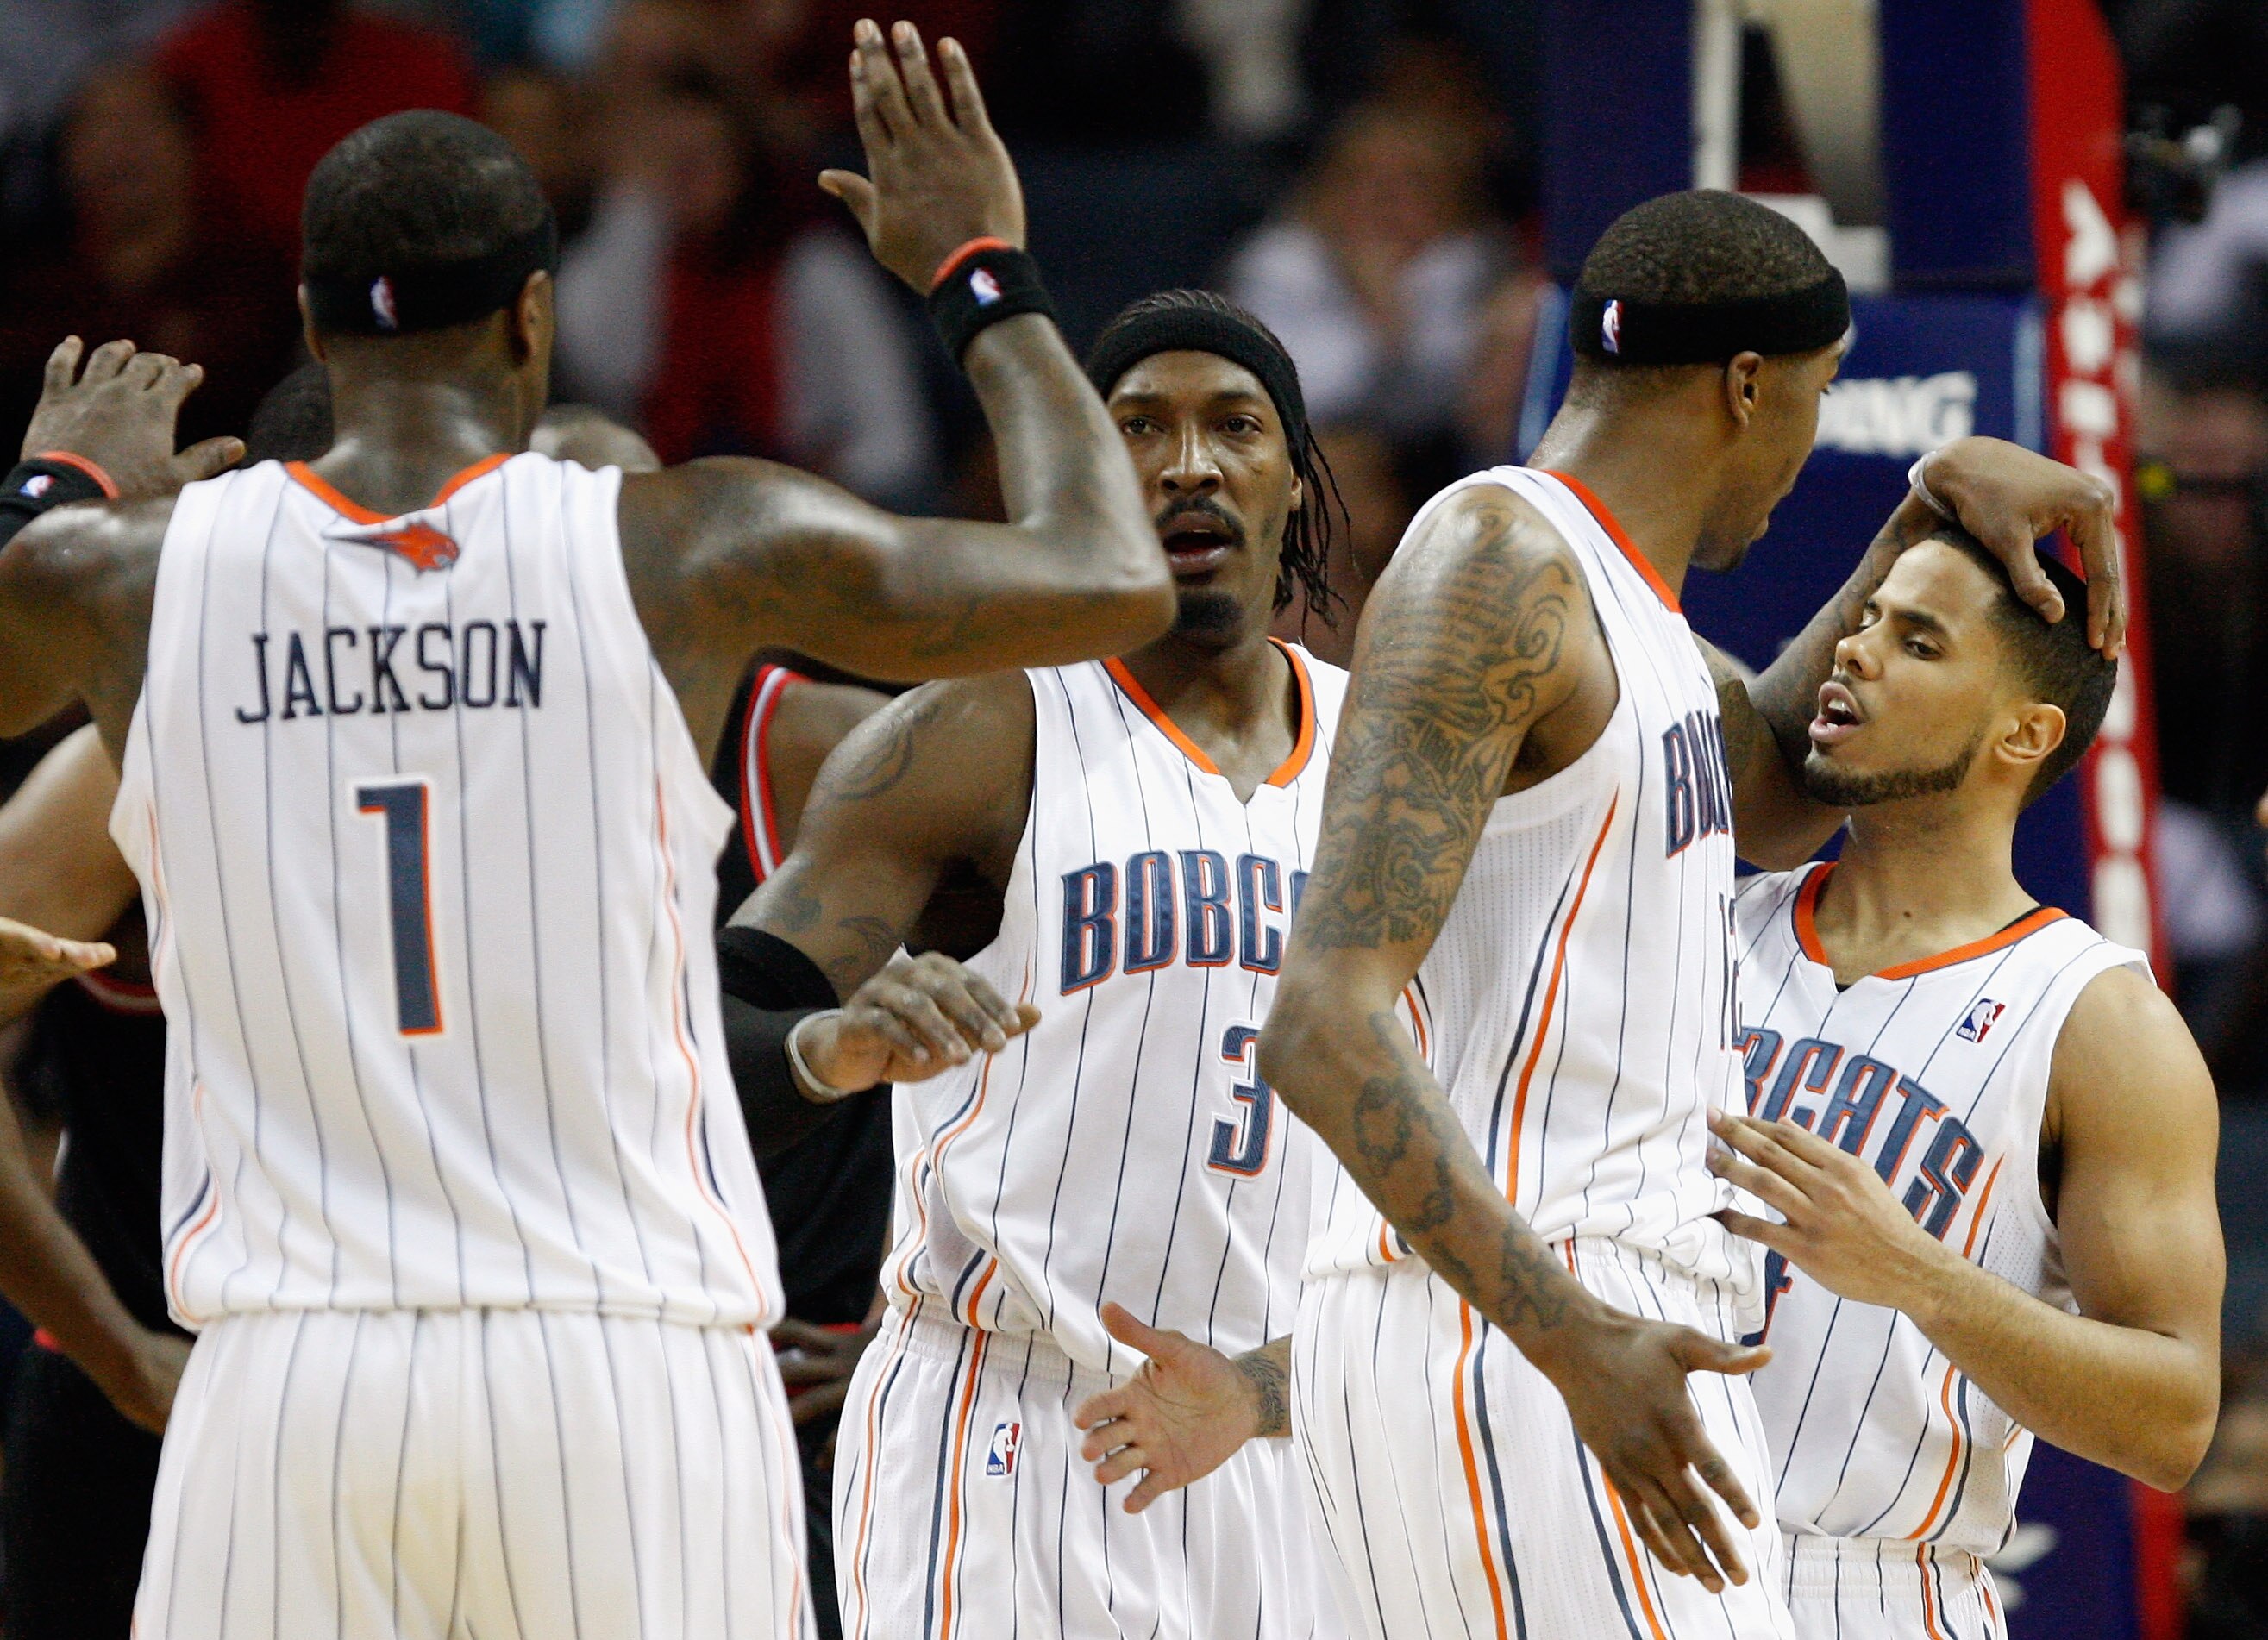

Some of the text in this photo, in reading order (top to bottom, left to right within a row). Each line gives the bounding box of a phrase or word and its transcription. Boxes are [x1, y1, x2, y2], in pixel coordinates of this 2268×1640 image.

[235, 619, 547, 725] JACKSON
[355, 781, 444, 1038] 1
[1061, 848, 1310, 997] BOBC
[1206, 1025, 1276, 1179] 3
